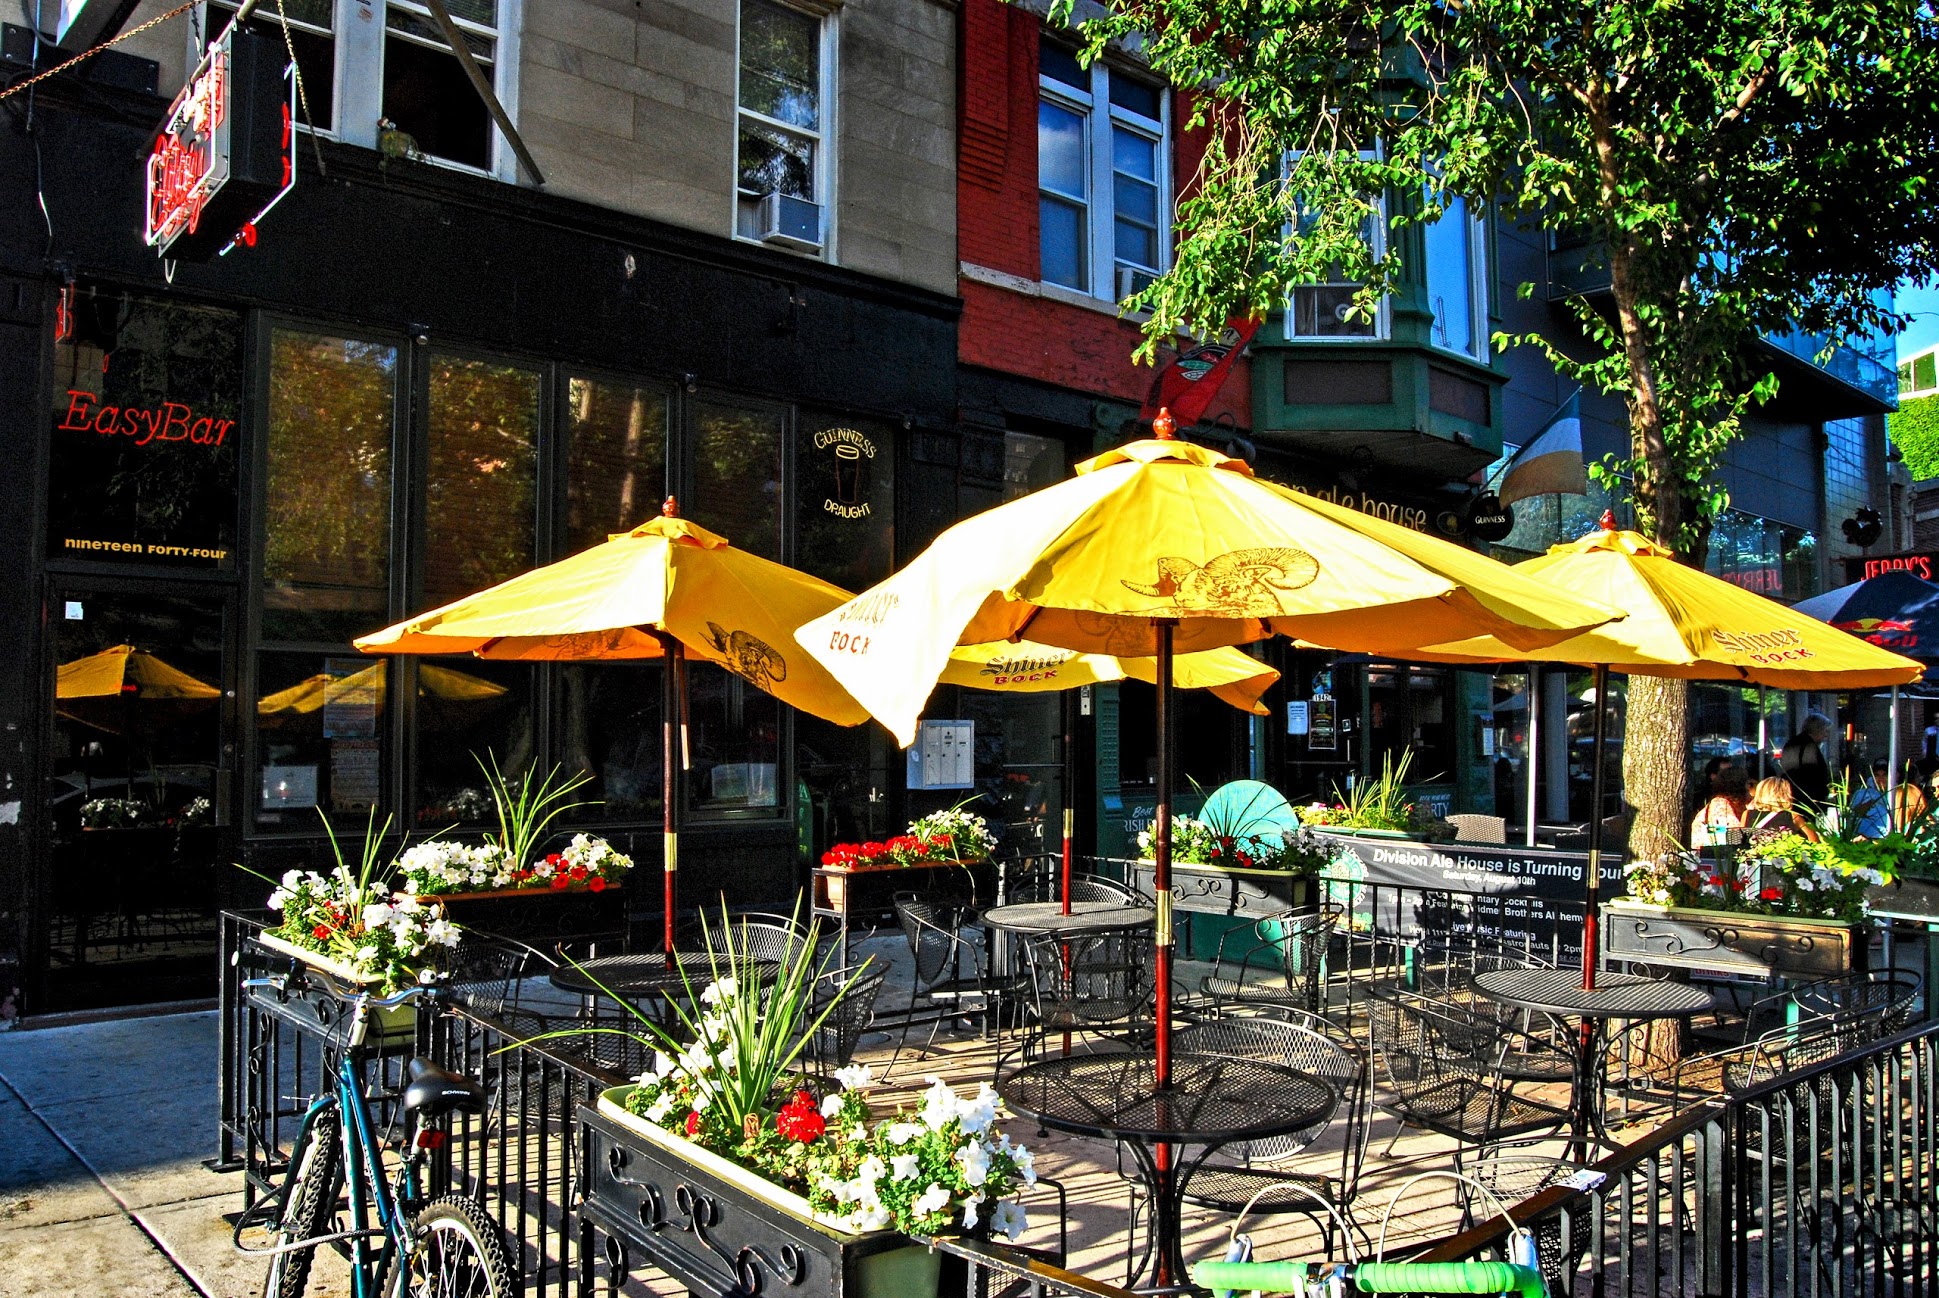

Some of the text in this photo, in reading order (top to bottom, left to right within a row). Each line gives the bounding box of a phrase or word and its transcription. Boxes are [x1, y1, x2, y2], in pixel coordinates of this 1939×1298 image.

[58, 390, 235, 446] EasyBar
[814, 428, 877, 458] GUINNESS
[824, 499, 871, 518] DRAUGHT
[1475, 514, 1506, 524] GUINNESS
[1713, 628, 1804, 653] Shiner
[980, 650, 1074, 675] Shiner
[1750, 648, 1815, 664] BOCK
[994, 670, 1058, 685] BOCK
[1373, 848, 1428, 866] Division
[1430, 854, 1454, 868] Ale
[1457, 856, 1503, 872] House
[1507, 859, 1520, 873] is
[1523, 860, 1582, 880] Turning
[1443, 870, 1536, 885] Saturday, August 10th
